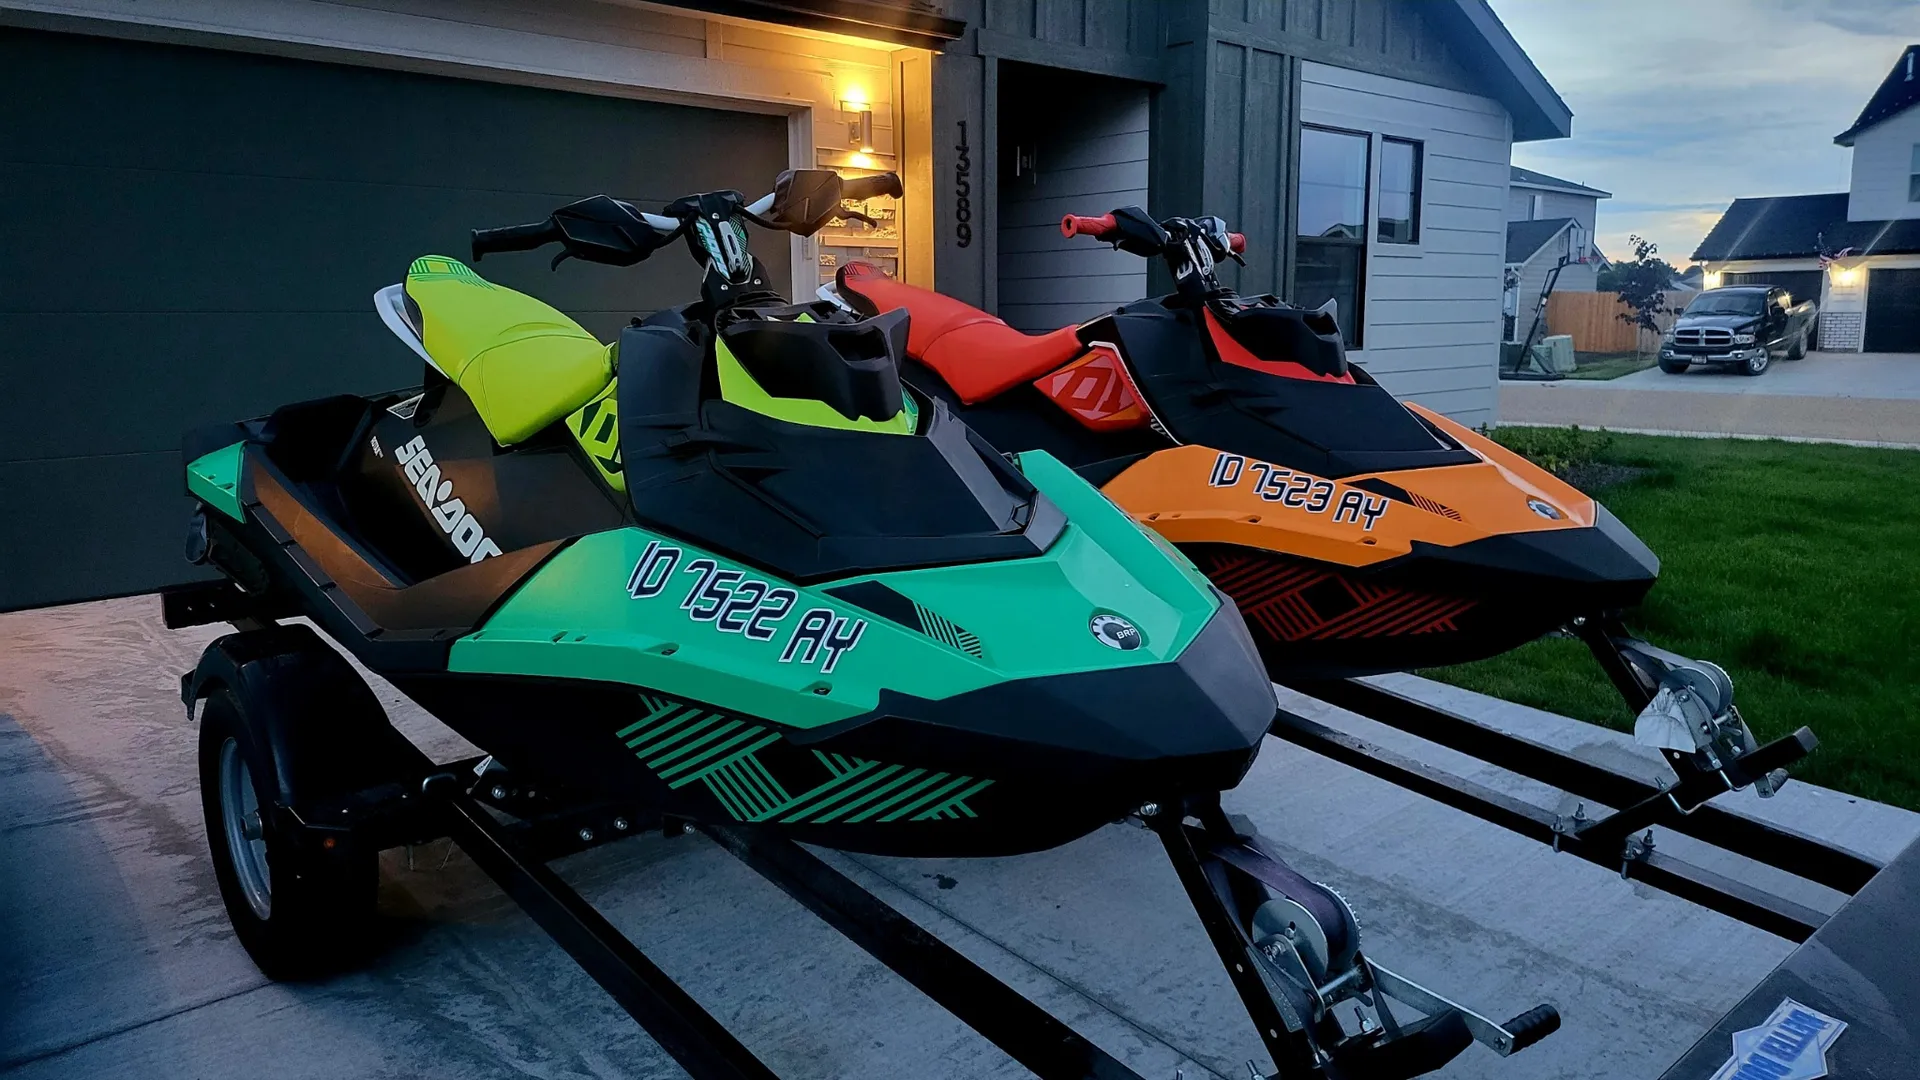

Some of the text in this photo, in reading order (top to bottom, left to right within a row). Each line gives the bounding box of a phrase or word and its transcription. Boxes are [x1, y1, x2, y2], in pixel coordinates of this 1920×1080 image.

[956, 120, 972, 248] 13589
[1208, 453, 1390, 532] ID 7523 AY
[626, 540, 868, 674] ID 7522 AY
[1116, 628, 1136, 639] BRP
